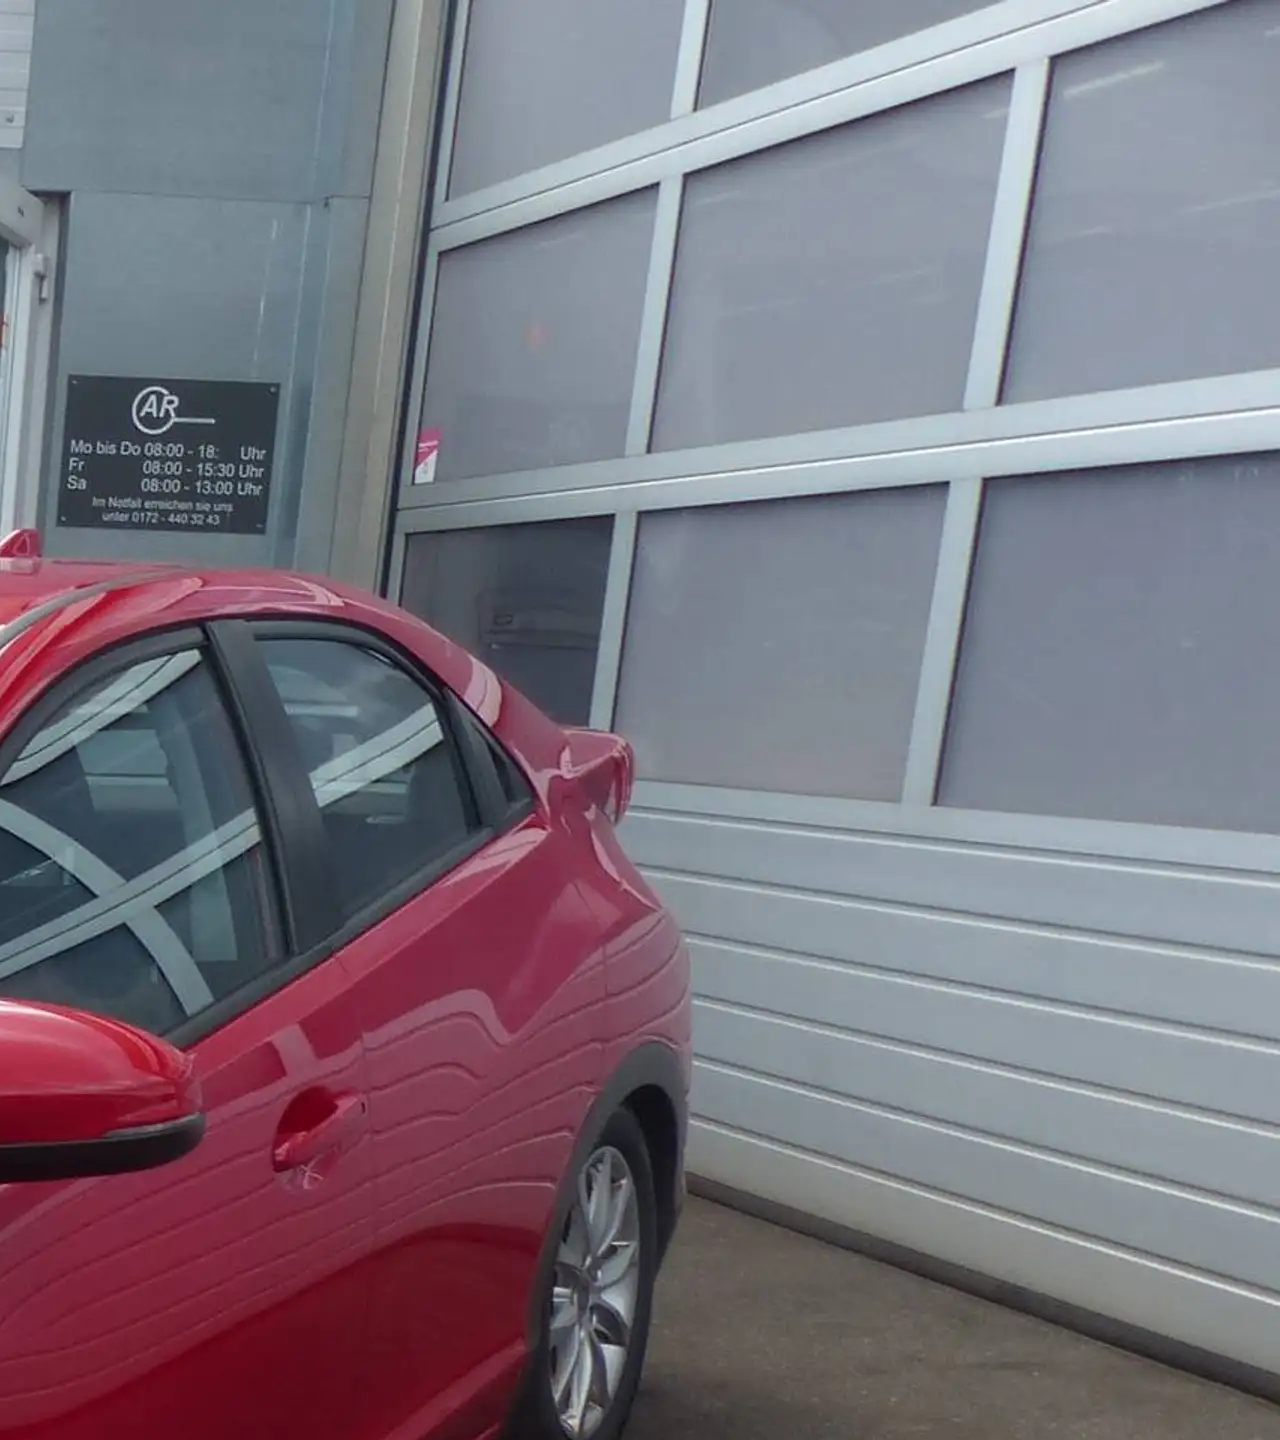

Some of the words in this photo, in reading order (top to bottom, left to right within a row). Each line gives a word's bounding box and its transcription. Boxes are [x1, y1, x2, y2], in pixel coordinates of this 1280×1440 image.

[70, 440, 92, 454] Mo
[96, 441, 116, 455] bis
[120, 441, 141, 456] Do
[144, 443, 184, 457] 08:00
[240, 446, 266, 460] Uhr
[69, 458, 84, 471] Fr
[143, 461, 182, 475] 08:00
[197, 463, 236, 477] 15:30
[238, 464, 264, 478] Uhr
[67, 476, 87, 490] Sa
[141, 479, 181, 493] 08:00
[195, 481, 233, 495] 13:00
[237, 482, 263, 496] Uhr
[92, 497, 105, 507] Im
[144, 499, 193, 511] erreichen
[132, 512, 158, 524] 0172
